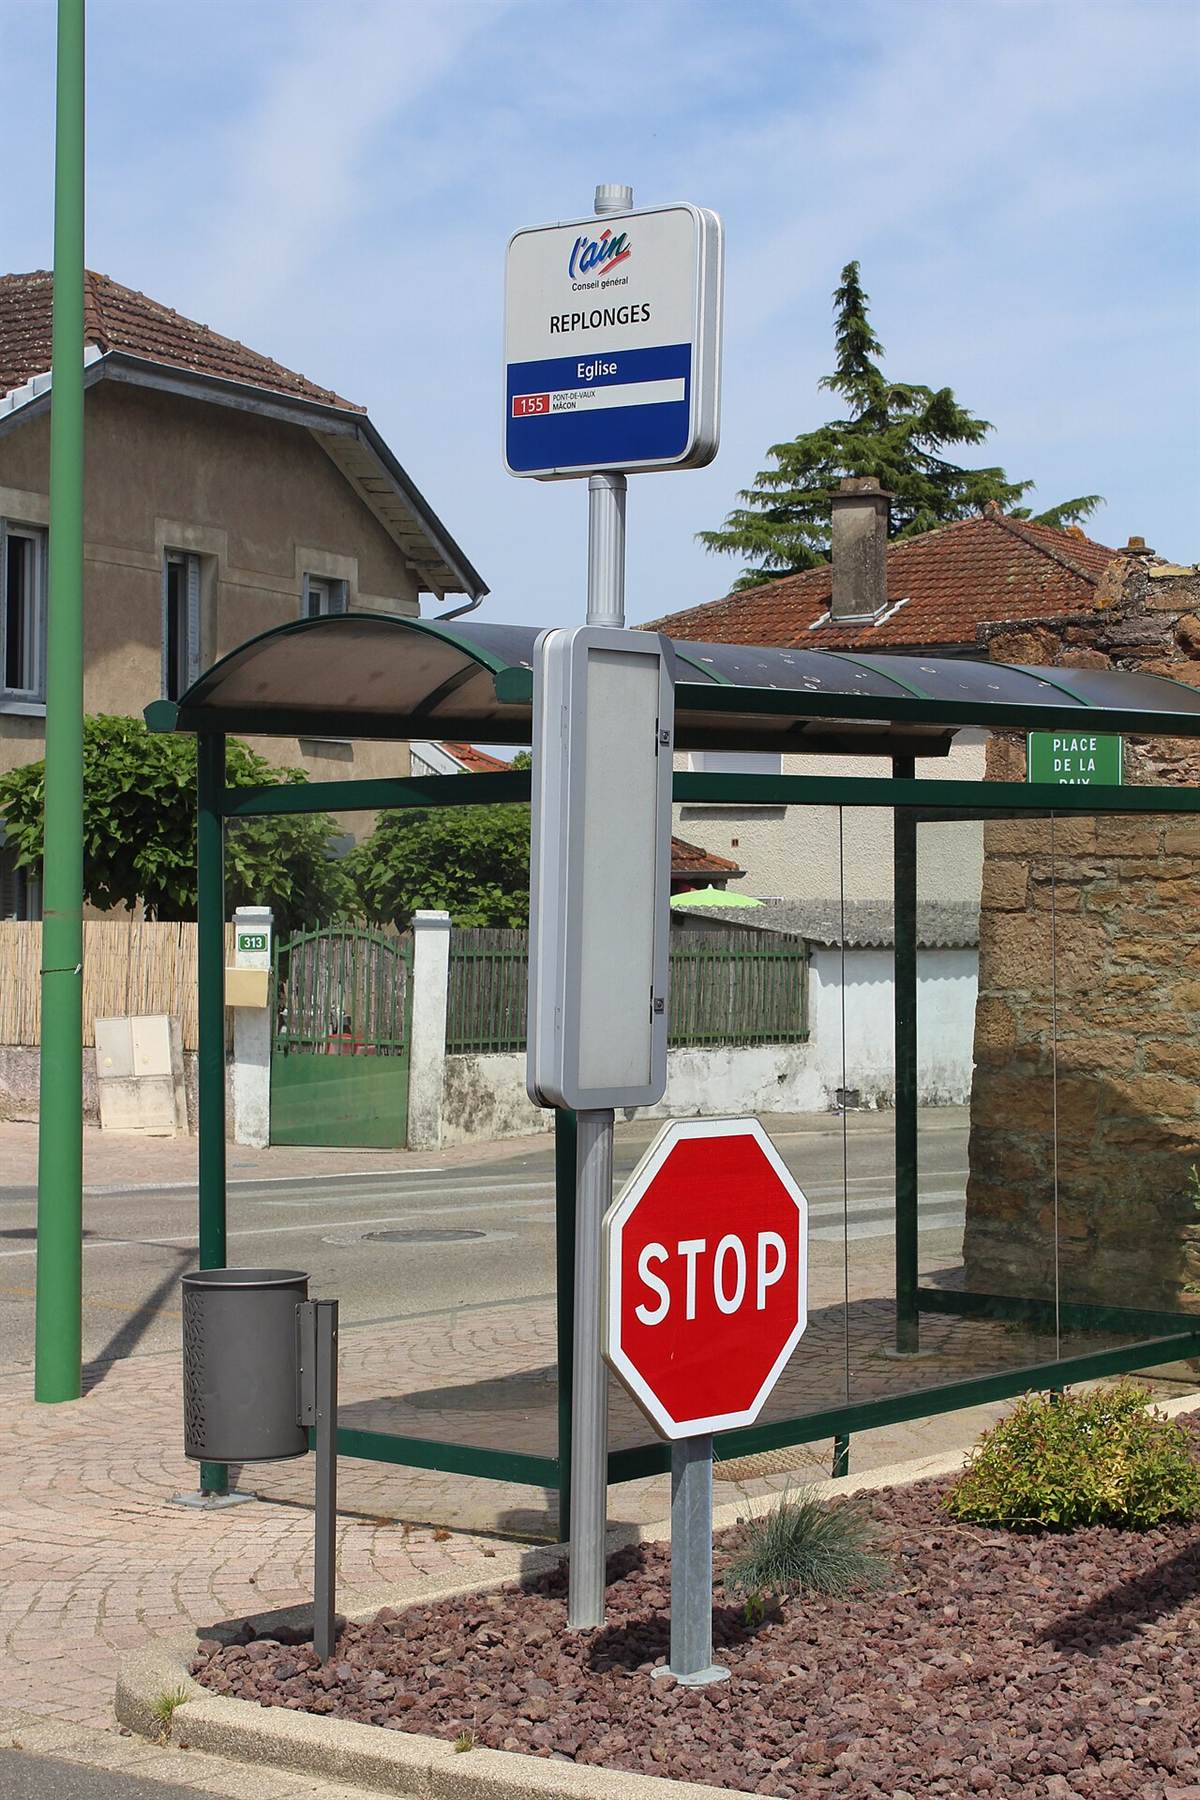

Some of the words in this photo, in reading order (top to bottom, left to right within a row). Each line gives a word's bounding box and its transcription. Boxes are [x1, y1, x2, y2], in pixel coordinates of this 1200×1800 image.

[572, 280, 600, 292] Conseil
[601, 276, 629, 290] général
[549, 303, 651, 334] REPLONGES
[577, 361, 618, 381] Eglise
[520, 397, 544, 413] 155
[552, 390, 596, 402] PONT-DE-VAUX
[1053, 737, 1097, 752] PLACE
[1054, 758, 1072, 772] DE
[1079, 758, 1096, 771] LA
[244, 937, 263, 949] 313
[634, 1230, 788, 1327] STOP
